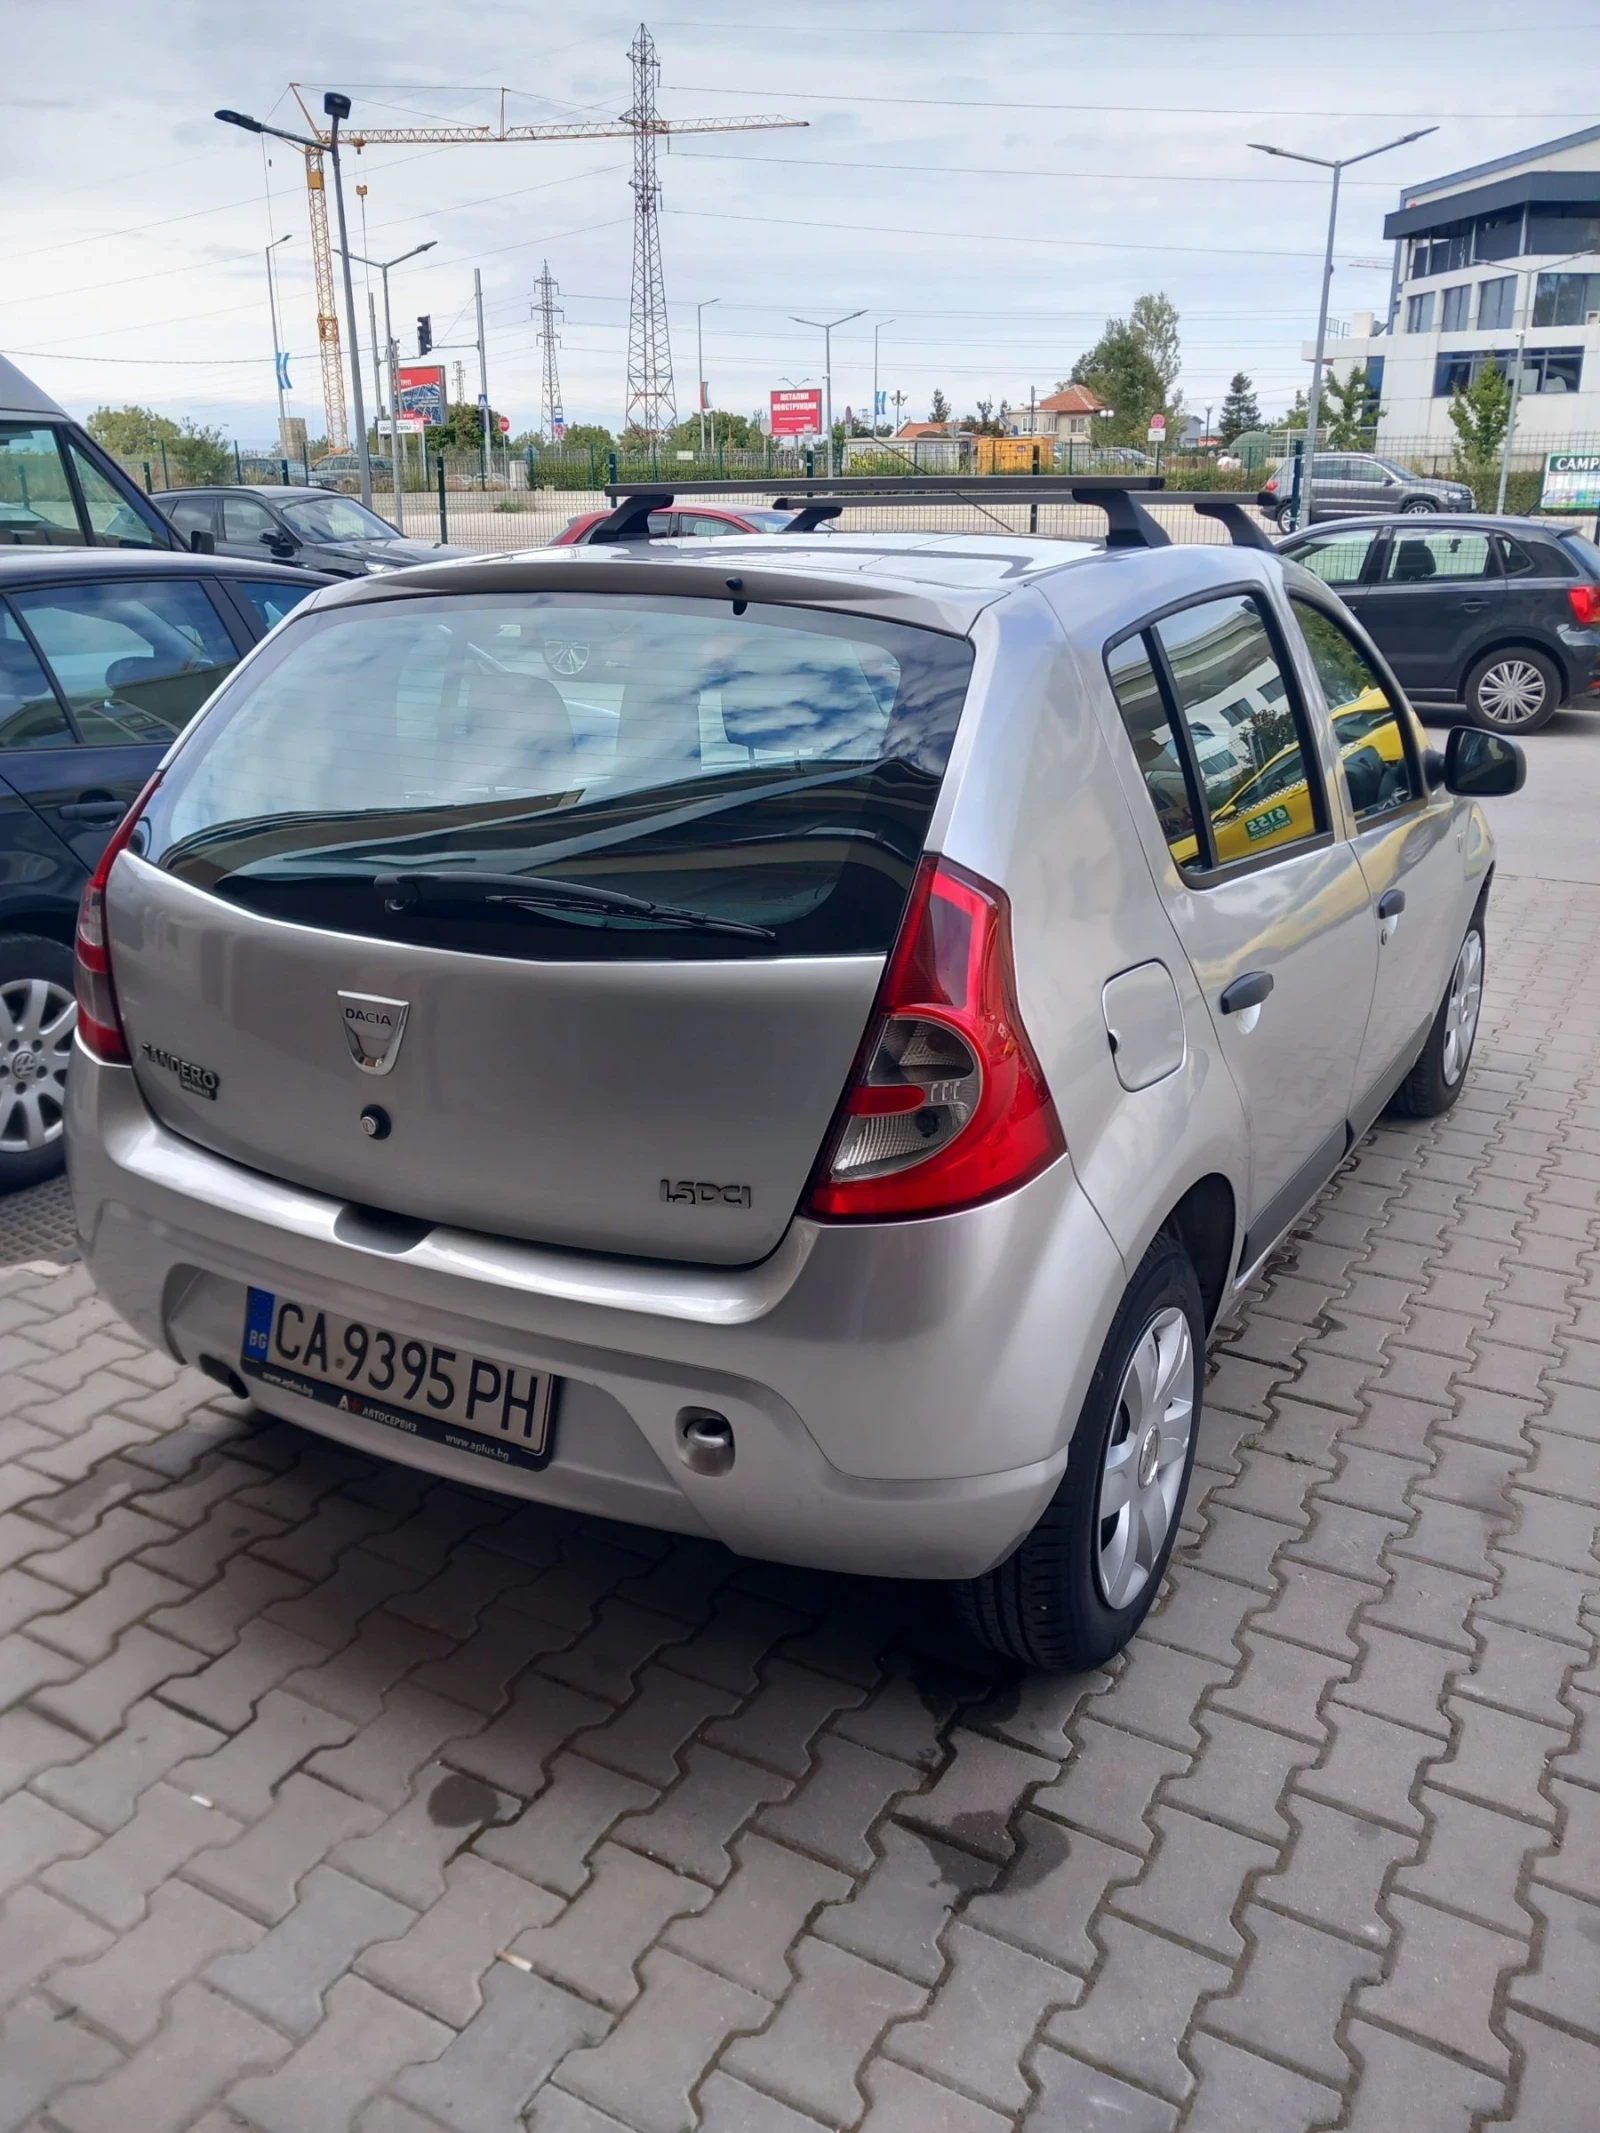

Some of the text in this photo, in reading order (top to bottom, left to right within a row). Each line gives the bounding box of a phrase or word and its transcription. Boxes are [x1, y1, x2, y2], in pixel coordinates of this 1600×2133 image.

[1556, 457, 1600, 470] CAMP
[345, 1008, 392, 1026] DACIA
[249, 1329, 267, 1349] BG
[343, 1324, 457, 1410] 9395
[362, 1407, 417, 1432] АВТОСЕРВИЗ
[445, 1433, 510, 1462] www.aplus.bg
